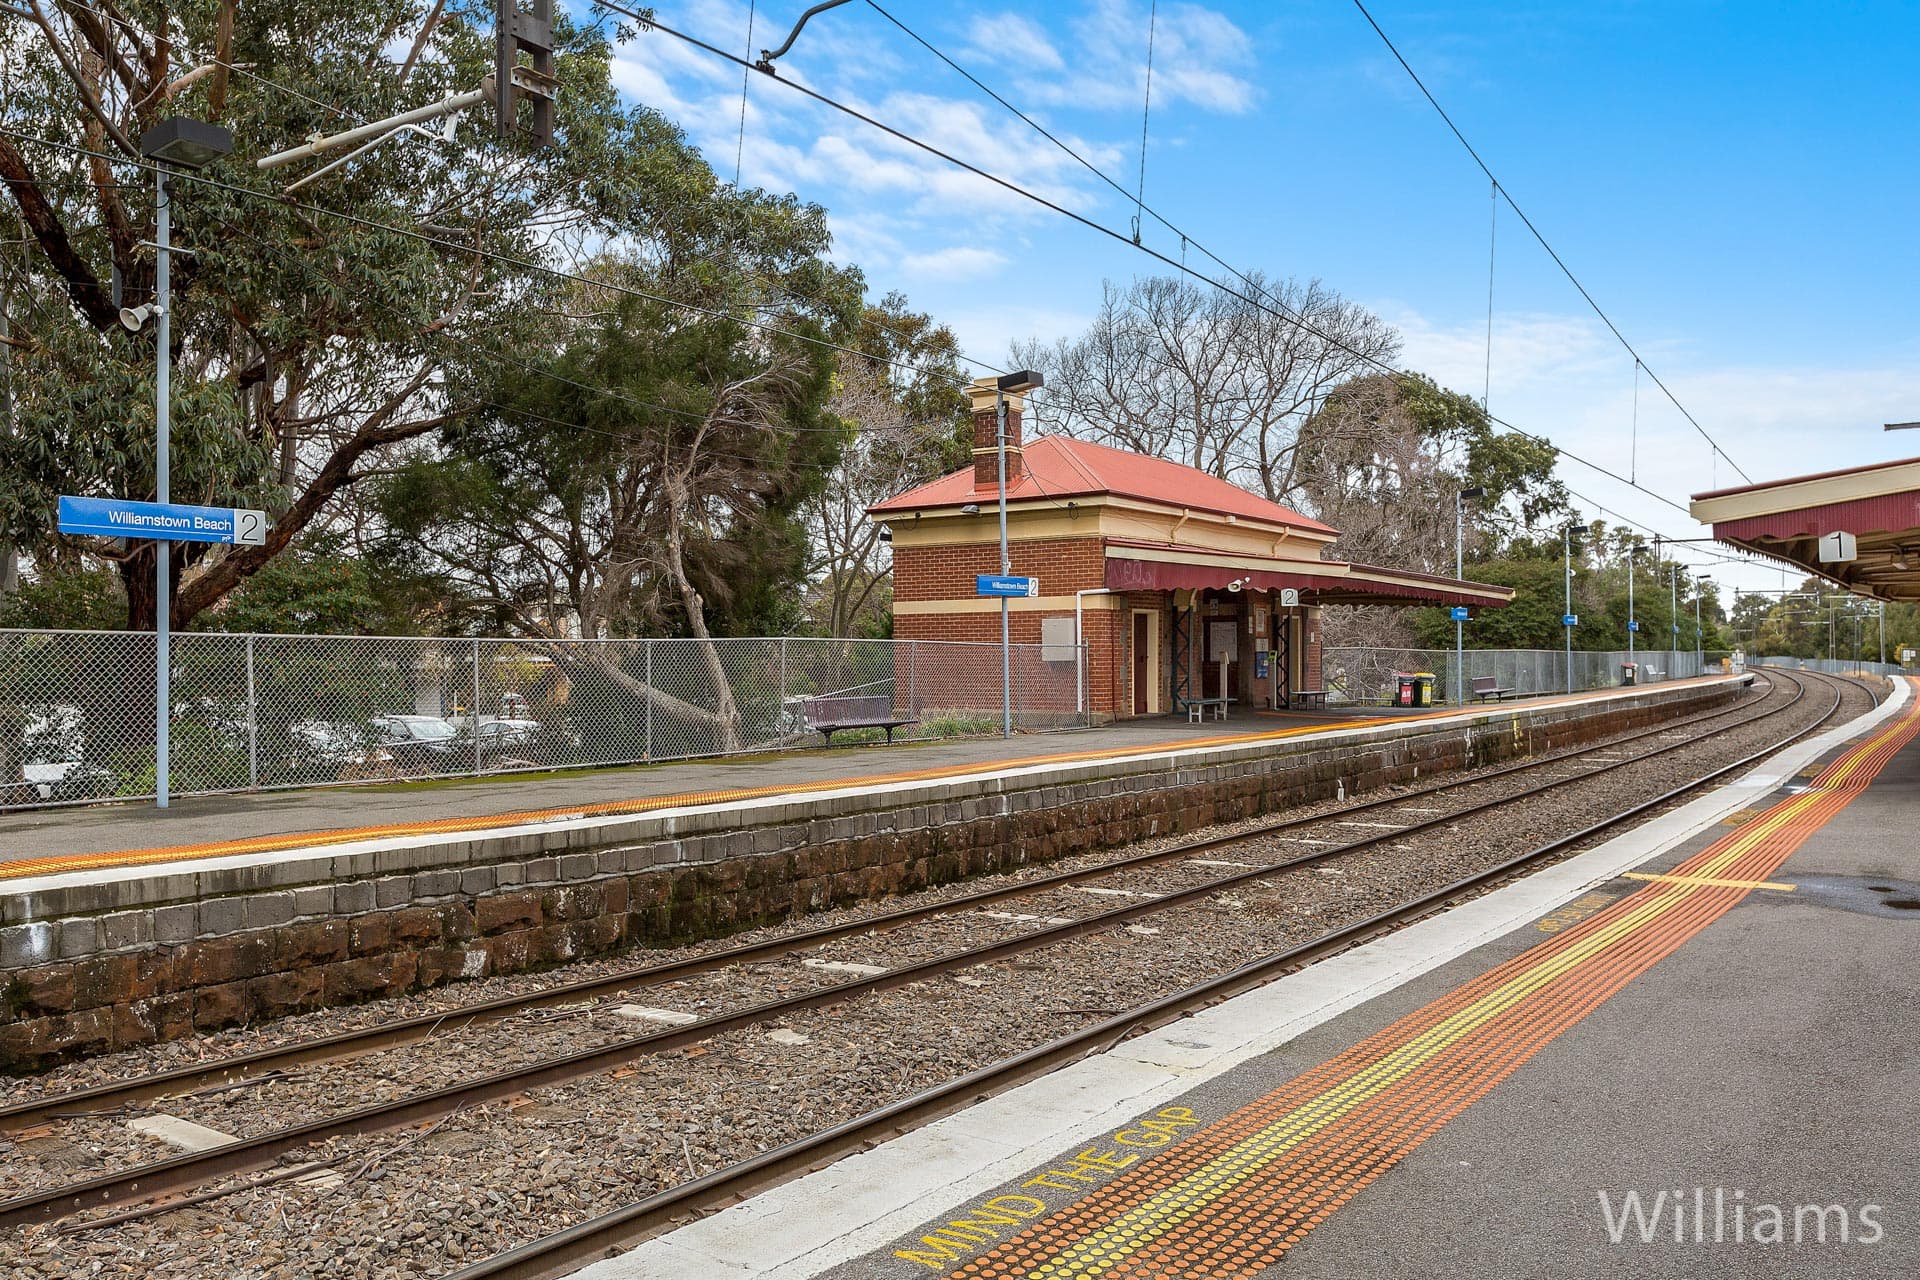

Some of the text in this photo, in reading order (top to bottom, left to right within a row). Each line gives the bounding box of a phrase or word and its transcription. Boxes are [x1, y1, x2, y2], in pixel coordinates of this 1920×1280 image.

[108, 511, 232, 531] Williamstown Beach
[241, 514, 258, 542] 2
[1830, 532, 1843, 558] 1
[1030, 579, 1037, 595] 2
[1285, 590, 1294, 605] 2
[892, 1106, 1201, 1270] MIND THE GAP
